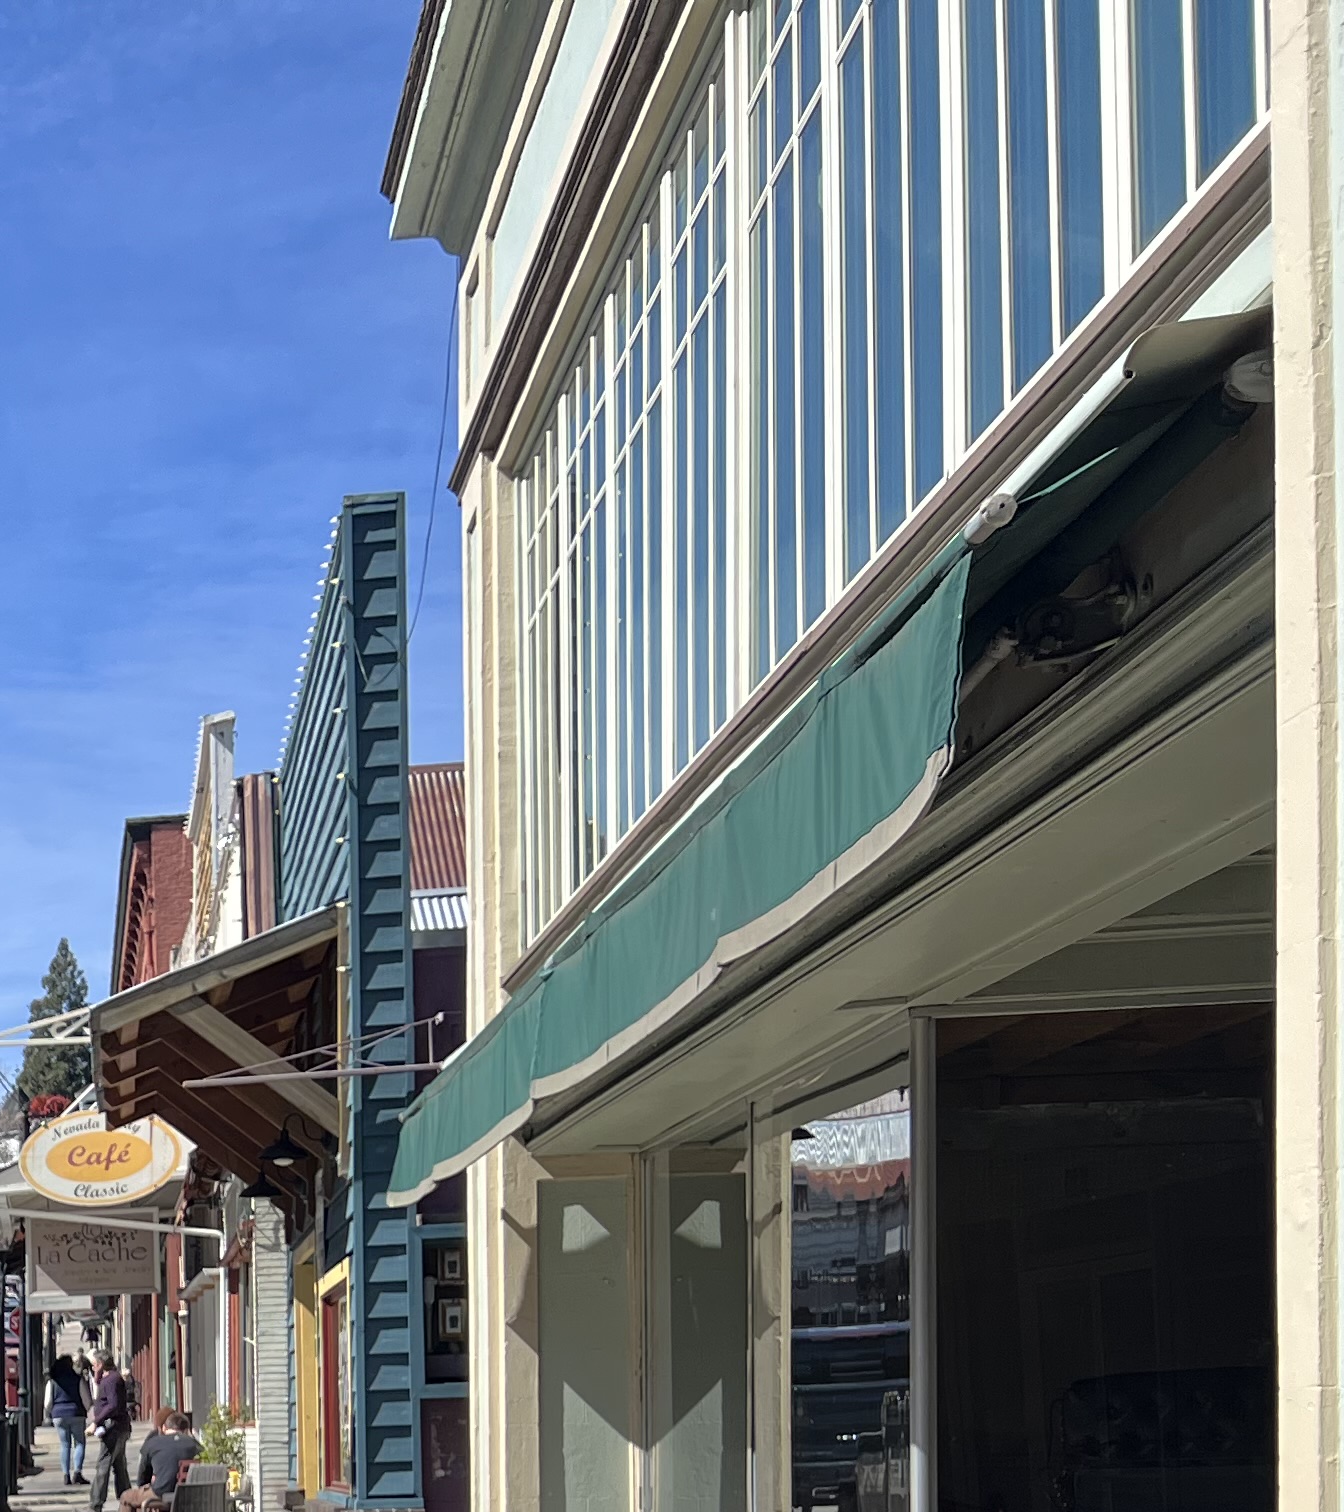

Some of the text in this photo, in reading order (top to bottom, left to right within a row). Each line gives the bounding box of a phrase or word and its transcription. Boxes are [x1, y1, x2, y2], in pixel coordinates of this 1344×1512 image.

[52, 1117, 100, 1142] Nevada
[68, 1142, 132, 1172] Café
[73, 1182, 130, 1199] Classic
[37, 1242, 148, 1264] La Cache
